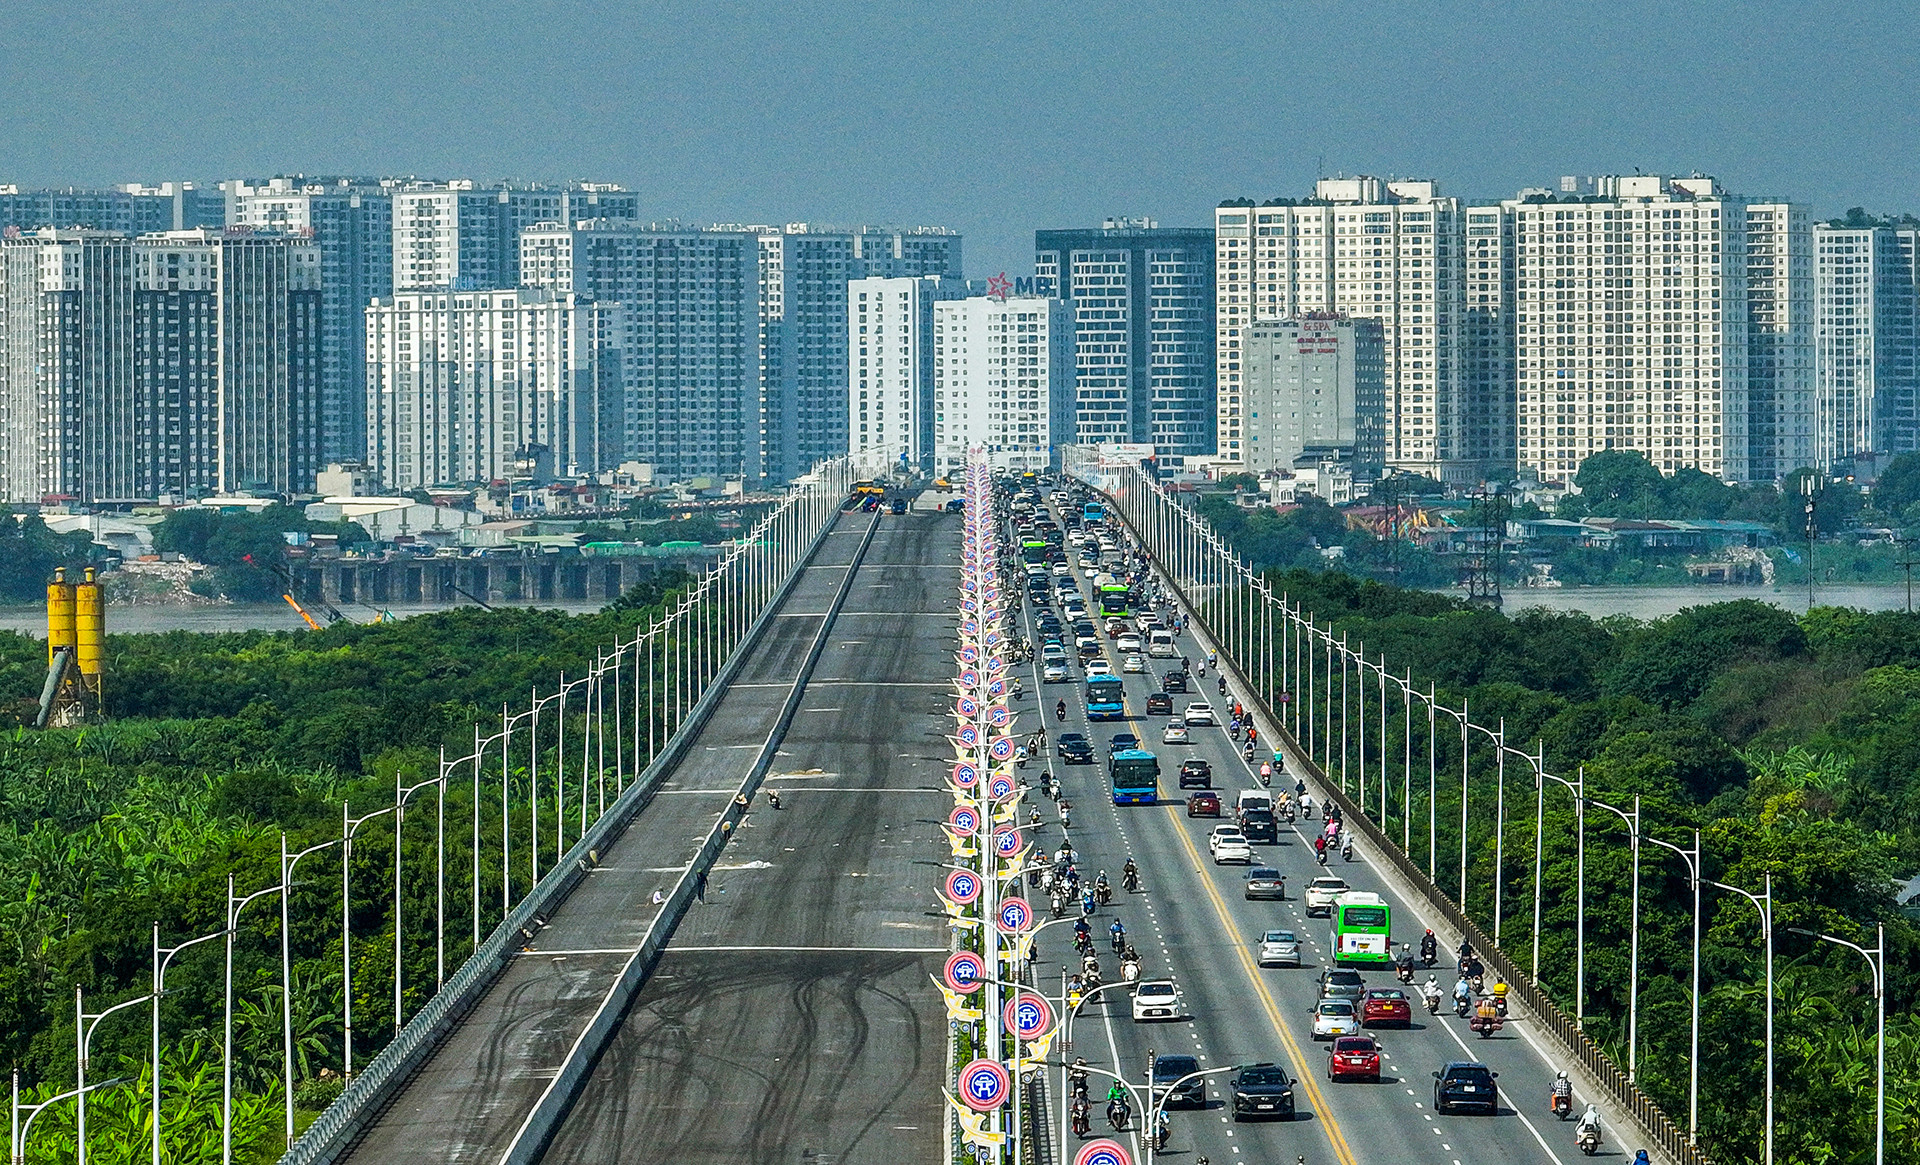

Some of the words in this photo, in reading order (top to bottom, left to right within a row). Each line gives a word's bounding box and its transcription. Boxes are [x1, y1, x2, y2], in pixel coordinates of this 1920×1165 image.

[1015, 276, 1051, 295] MB
[1303, 322, 1311, 331] &
[1313, 322, 1331, 331] SPA
